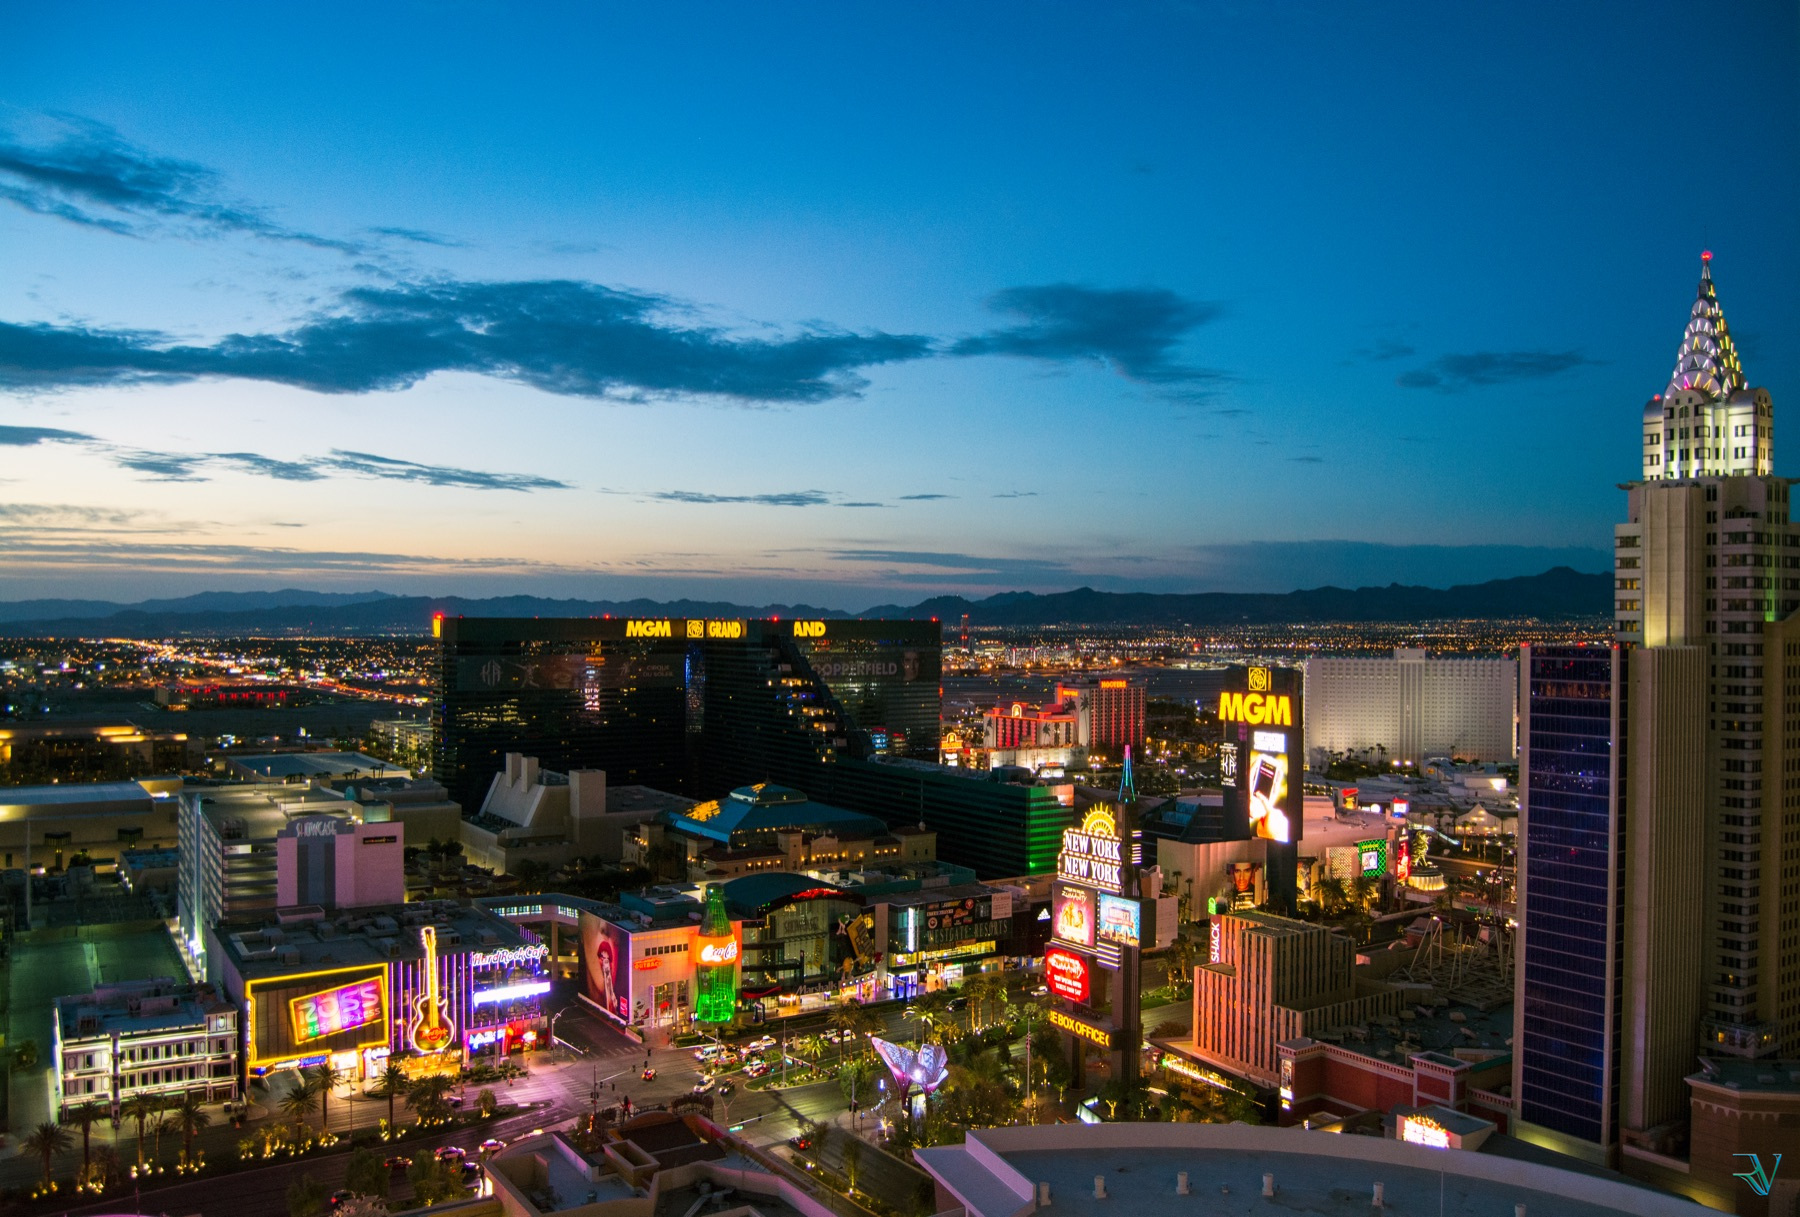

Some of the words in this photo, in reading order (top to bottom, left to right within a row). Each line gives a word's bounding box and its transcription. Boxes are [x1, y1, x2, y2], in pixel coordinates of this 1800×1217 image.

[626, 621, 672, 638] MGM
[709, 620, 742, 639] GRAND
[793, 621, 827, 638] AND
[1101, 680, 1127, 689] HOOTERS
[1219, 692, 1291, 726] MGM
[296, 820, 337, 837] SHOWCASE
[1064, 833, 1089, 854] NEW
[1090, 839, 1121, 861] YORK
[1064, 856, 1089, 878] NEW
[1089, 861, 1121, 885] YORK
[1211, 922, 1221, 963] SHACK
[473, 950, 501, 966] Hard
[500, 947, 526, 964] Rock
[795, 981, 838, 997] Marshalls
[298, 985, 380, 1025] ROSS
[1058, 1014, 1075, 1032] BOX
[1075, 1021, 1105, 1046] OFFICE
